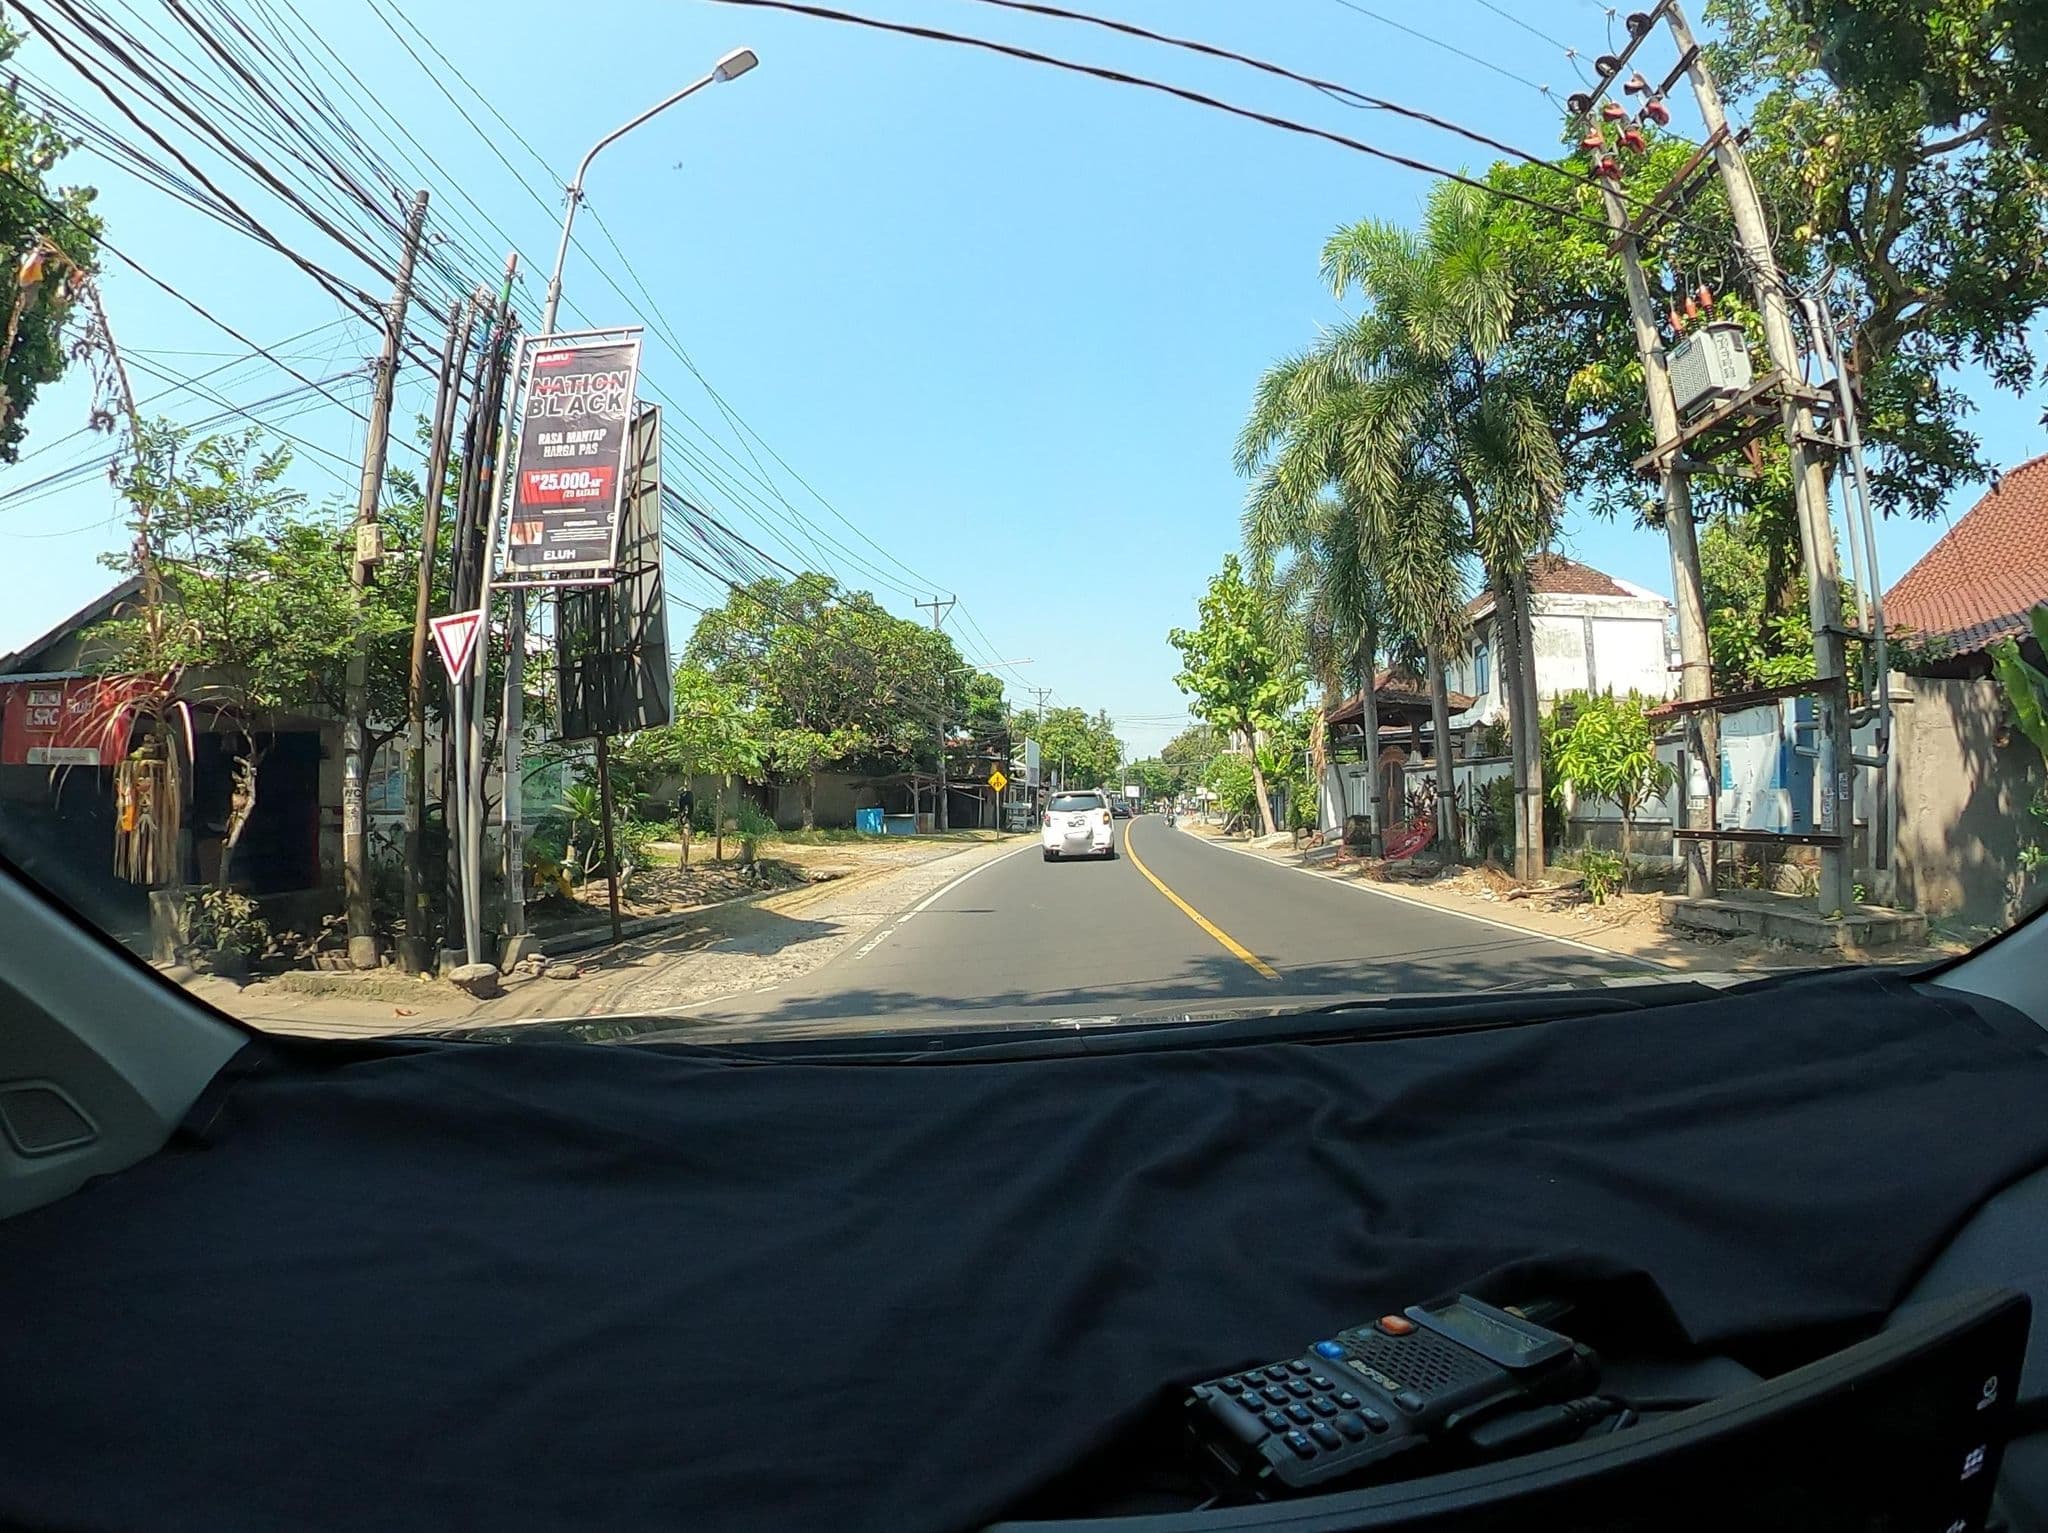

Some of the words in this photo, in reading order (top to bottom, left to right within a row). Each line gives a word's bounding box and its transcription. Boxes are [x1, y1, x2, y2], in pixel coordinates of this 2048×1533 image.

[531, 370, 630, 397] NATION
[528, 392, 625, 418] BLACK
[538, 432, 563, 445] RASA
[566, 429, 607, 443] MANTAP
[543, 444, 575, 458] HARGA
[579, 442, 598, 455] PAS
